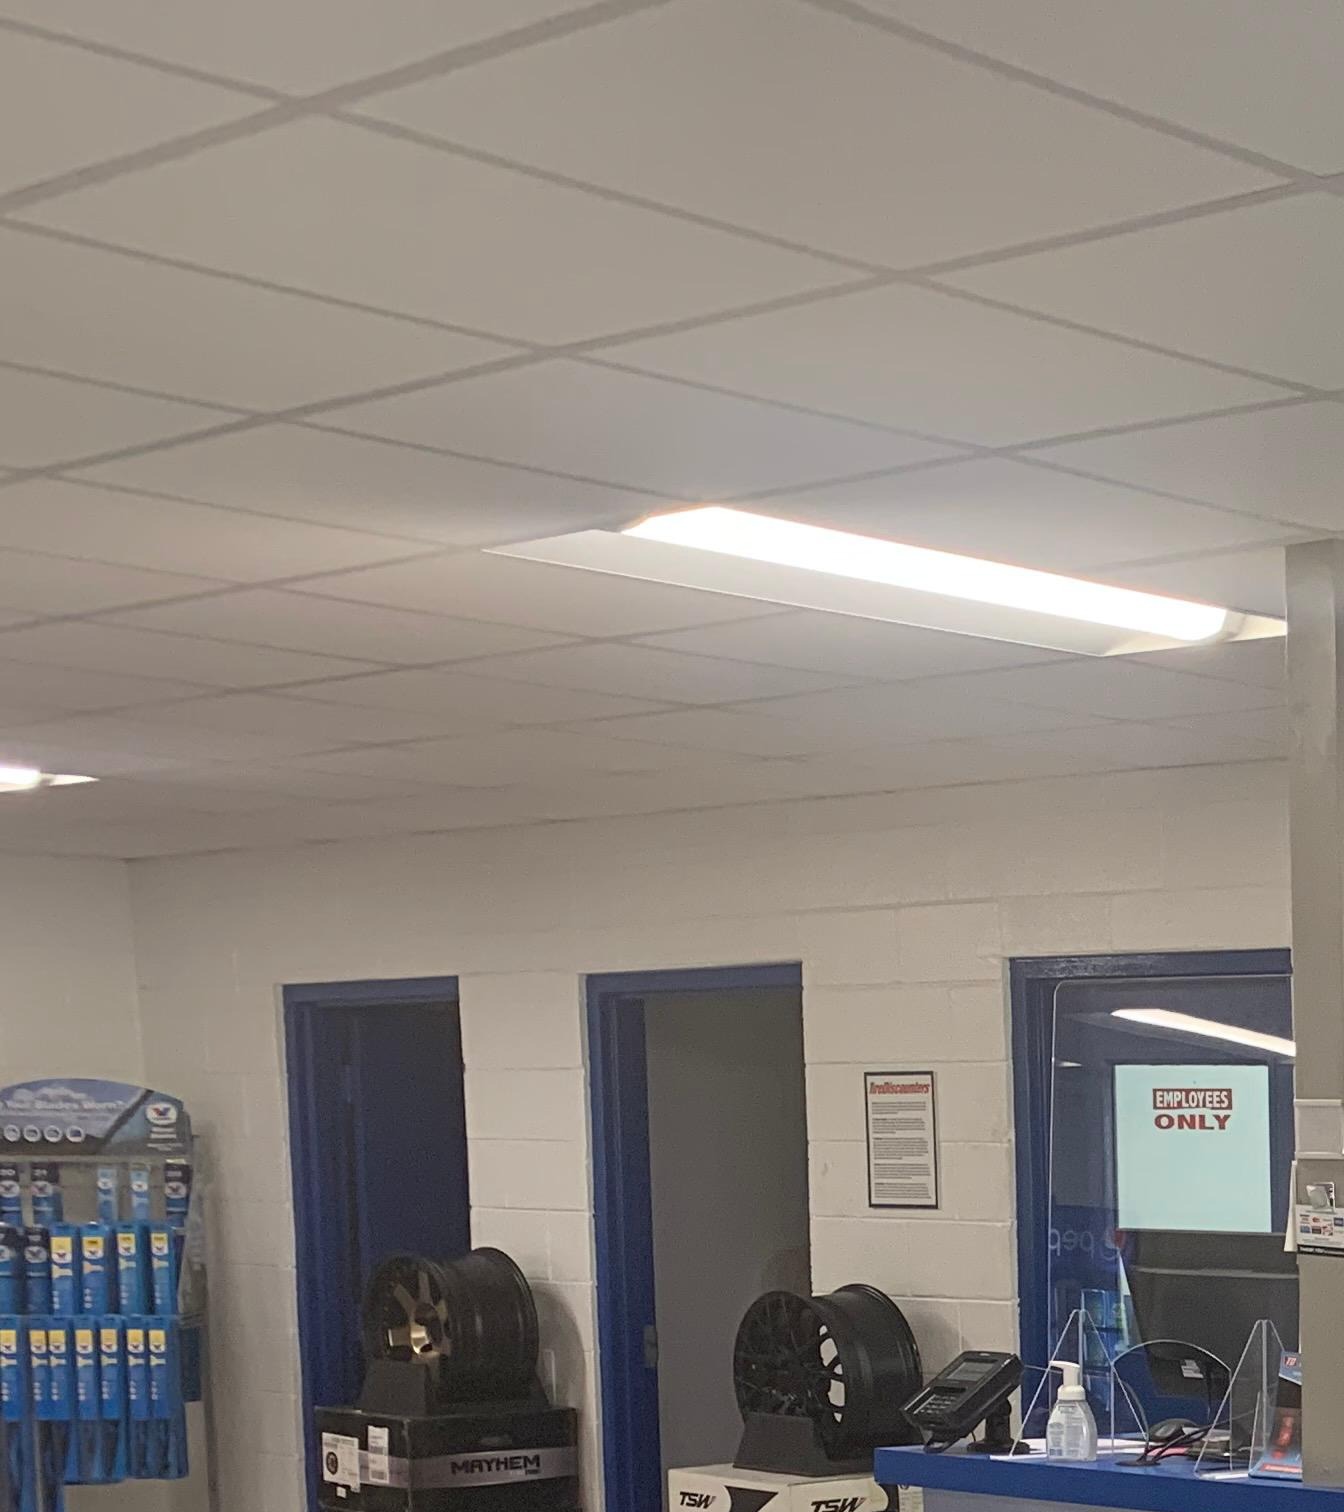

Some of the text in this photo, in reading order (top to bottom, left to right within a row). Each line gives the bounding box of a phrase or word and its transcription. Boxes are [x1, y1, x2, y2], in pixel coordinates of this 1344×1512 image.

[1155, 1090, 1229, 1108] EMPLOYEES
[1154, 1113, 1232, 1130] ONLY
[450, 1454, 541, 1475] MAYHEM
[679, 1491, 716, 1510] TSW
